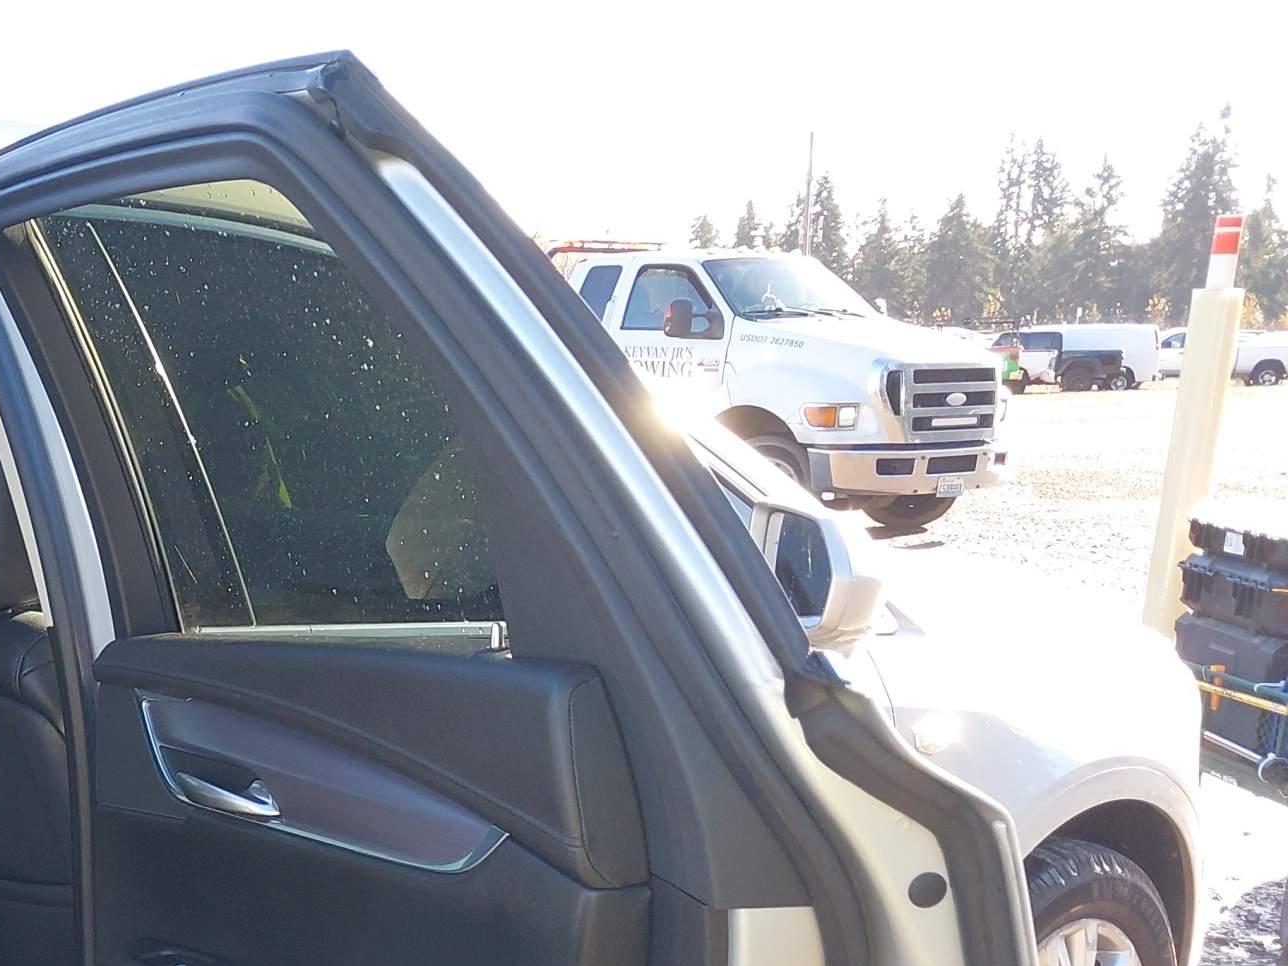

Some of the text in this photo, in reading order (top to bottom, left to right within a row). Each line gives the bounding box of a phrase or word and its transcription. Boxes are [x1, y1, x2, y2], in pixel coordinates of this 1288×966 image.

[740, 333, 768, 344] USDOT
[624, 345, 694, 361] KEYVAN JR'S
